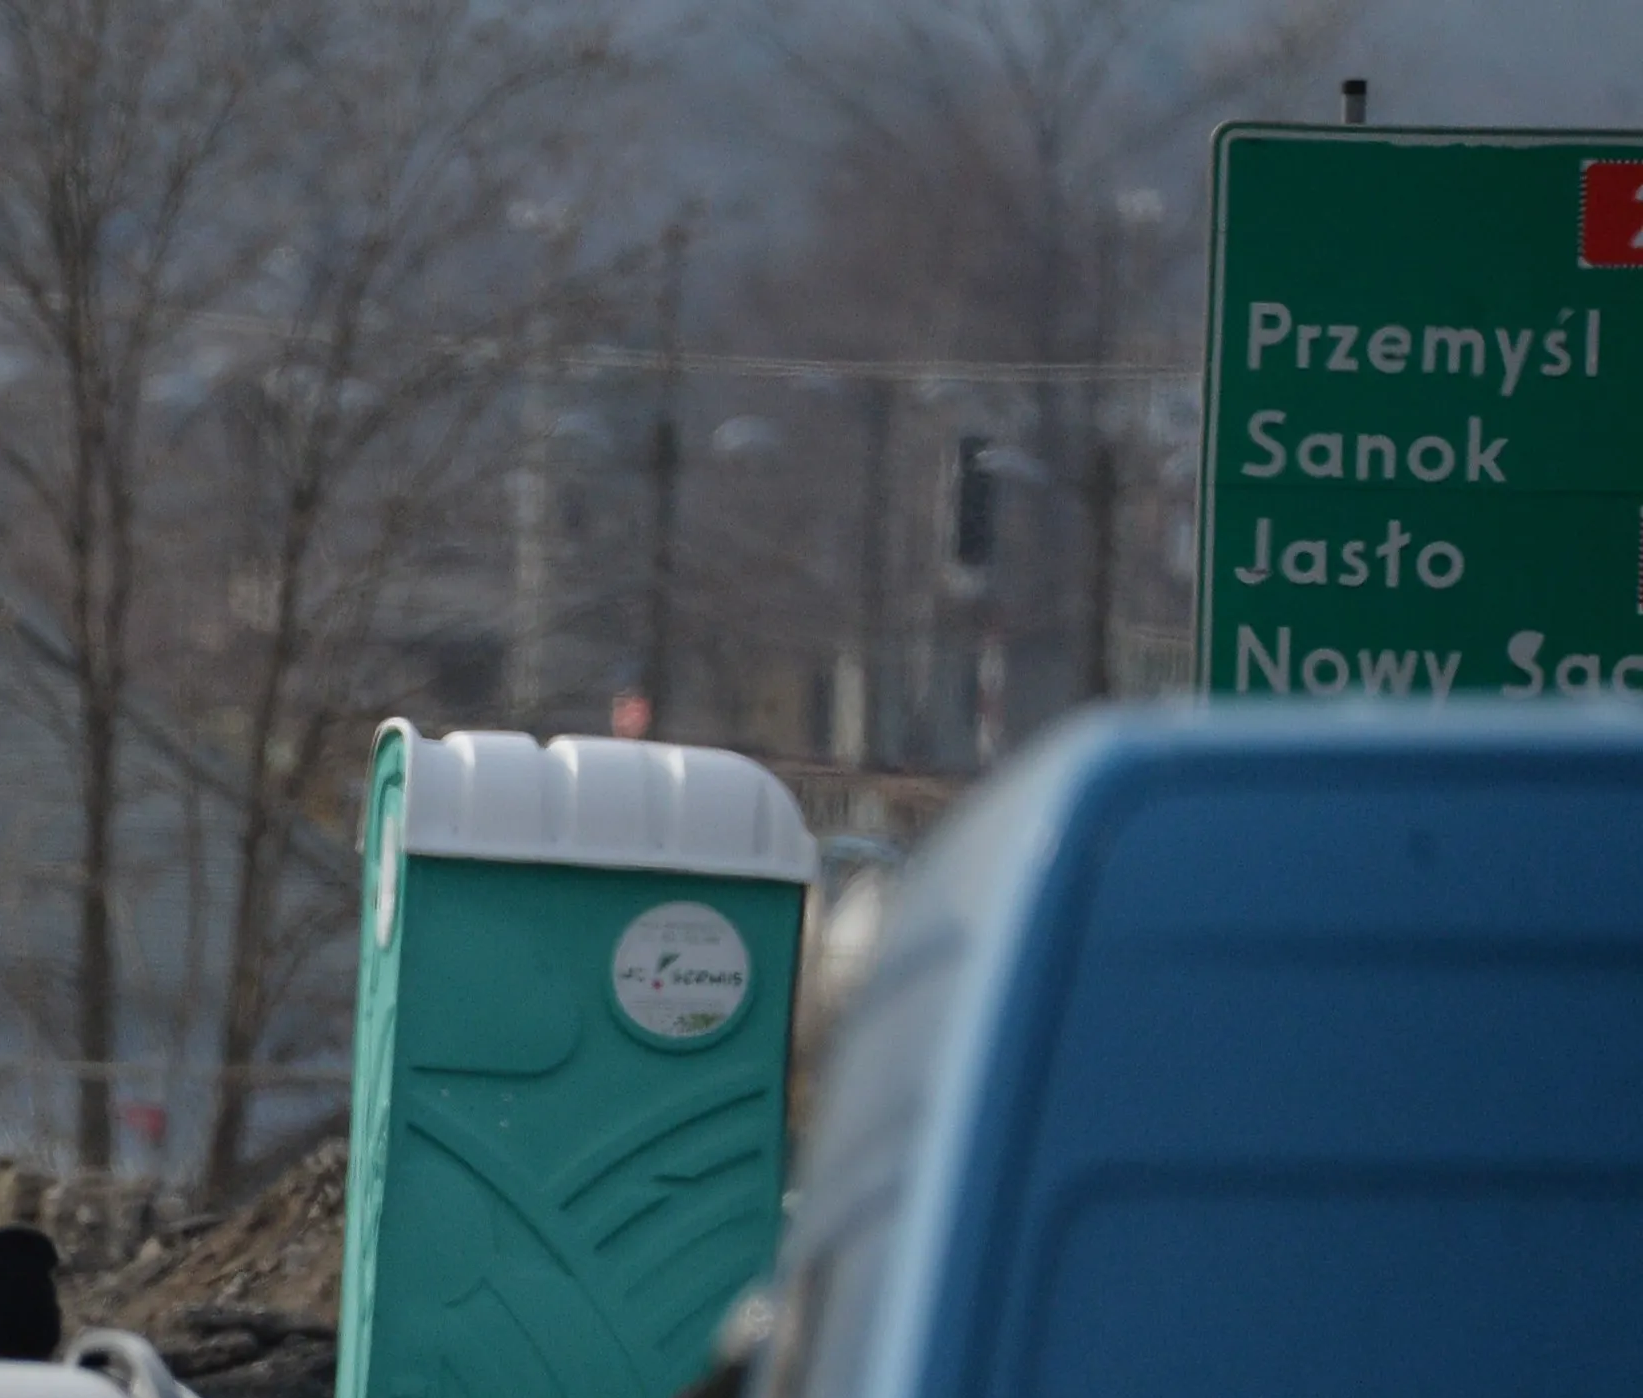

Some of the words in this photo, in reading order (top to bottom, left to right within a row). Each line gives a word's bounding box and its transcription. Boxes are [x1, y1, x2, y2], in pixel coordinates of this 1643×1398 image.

[1246, 301, 1602, 397] Przemyśl
[1239, 410, 1510, 483] Sanok
[1233, 516, 1467, 591] Jasło
[1236, 624, 1464, 706] Nowy
